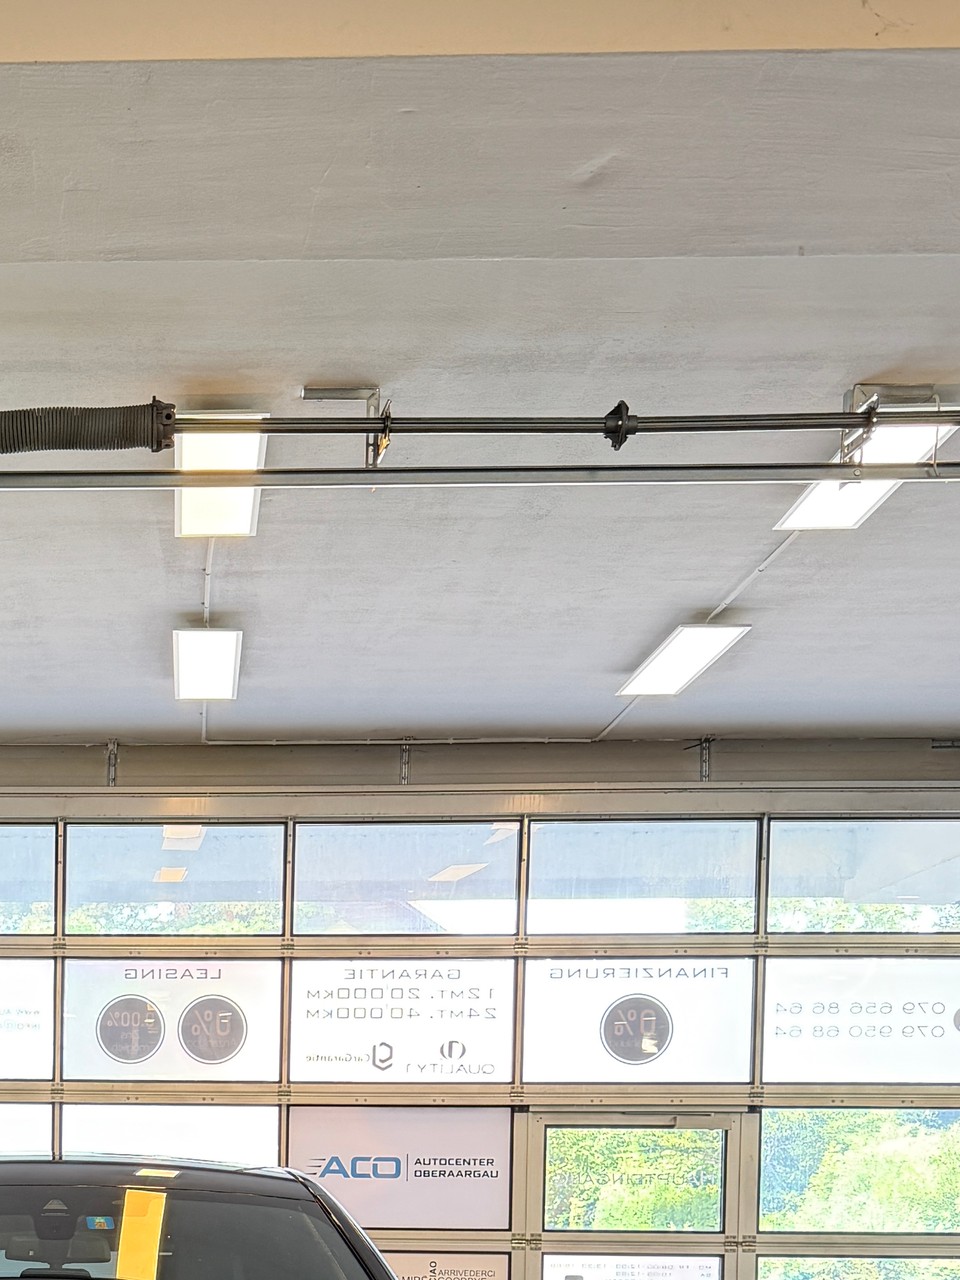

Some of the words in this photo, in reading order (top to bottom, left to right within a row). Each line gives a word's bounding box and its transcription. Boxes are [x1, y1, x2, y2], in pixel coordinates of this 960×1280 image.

[413, 1157, 495, 1167] AUTOCENTER
[317, 1156, 402, 1179] ACO
[413, 1169, 499, 1179] OBERAARGAU
[437, 1269, 496, 1278] ARRIVEDERCI
